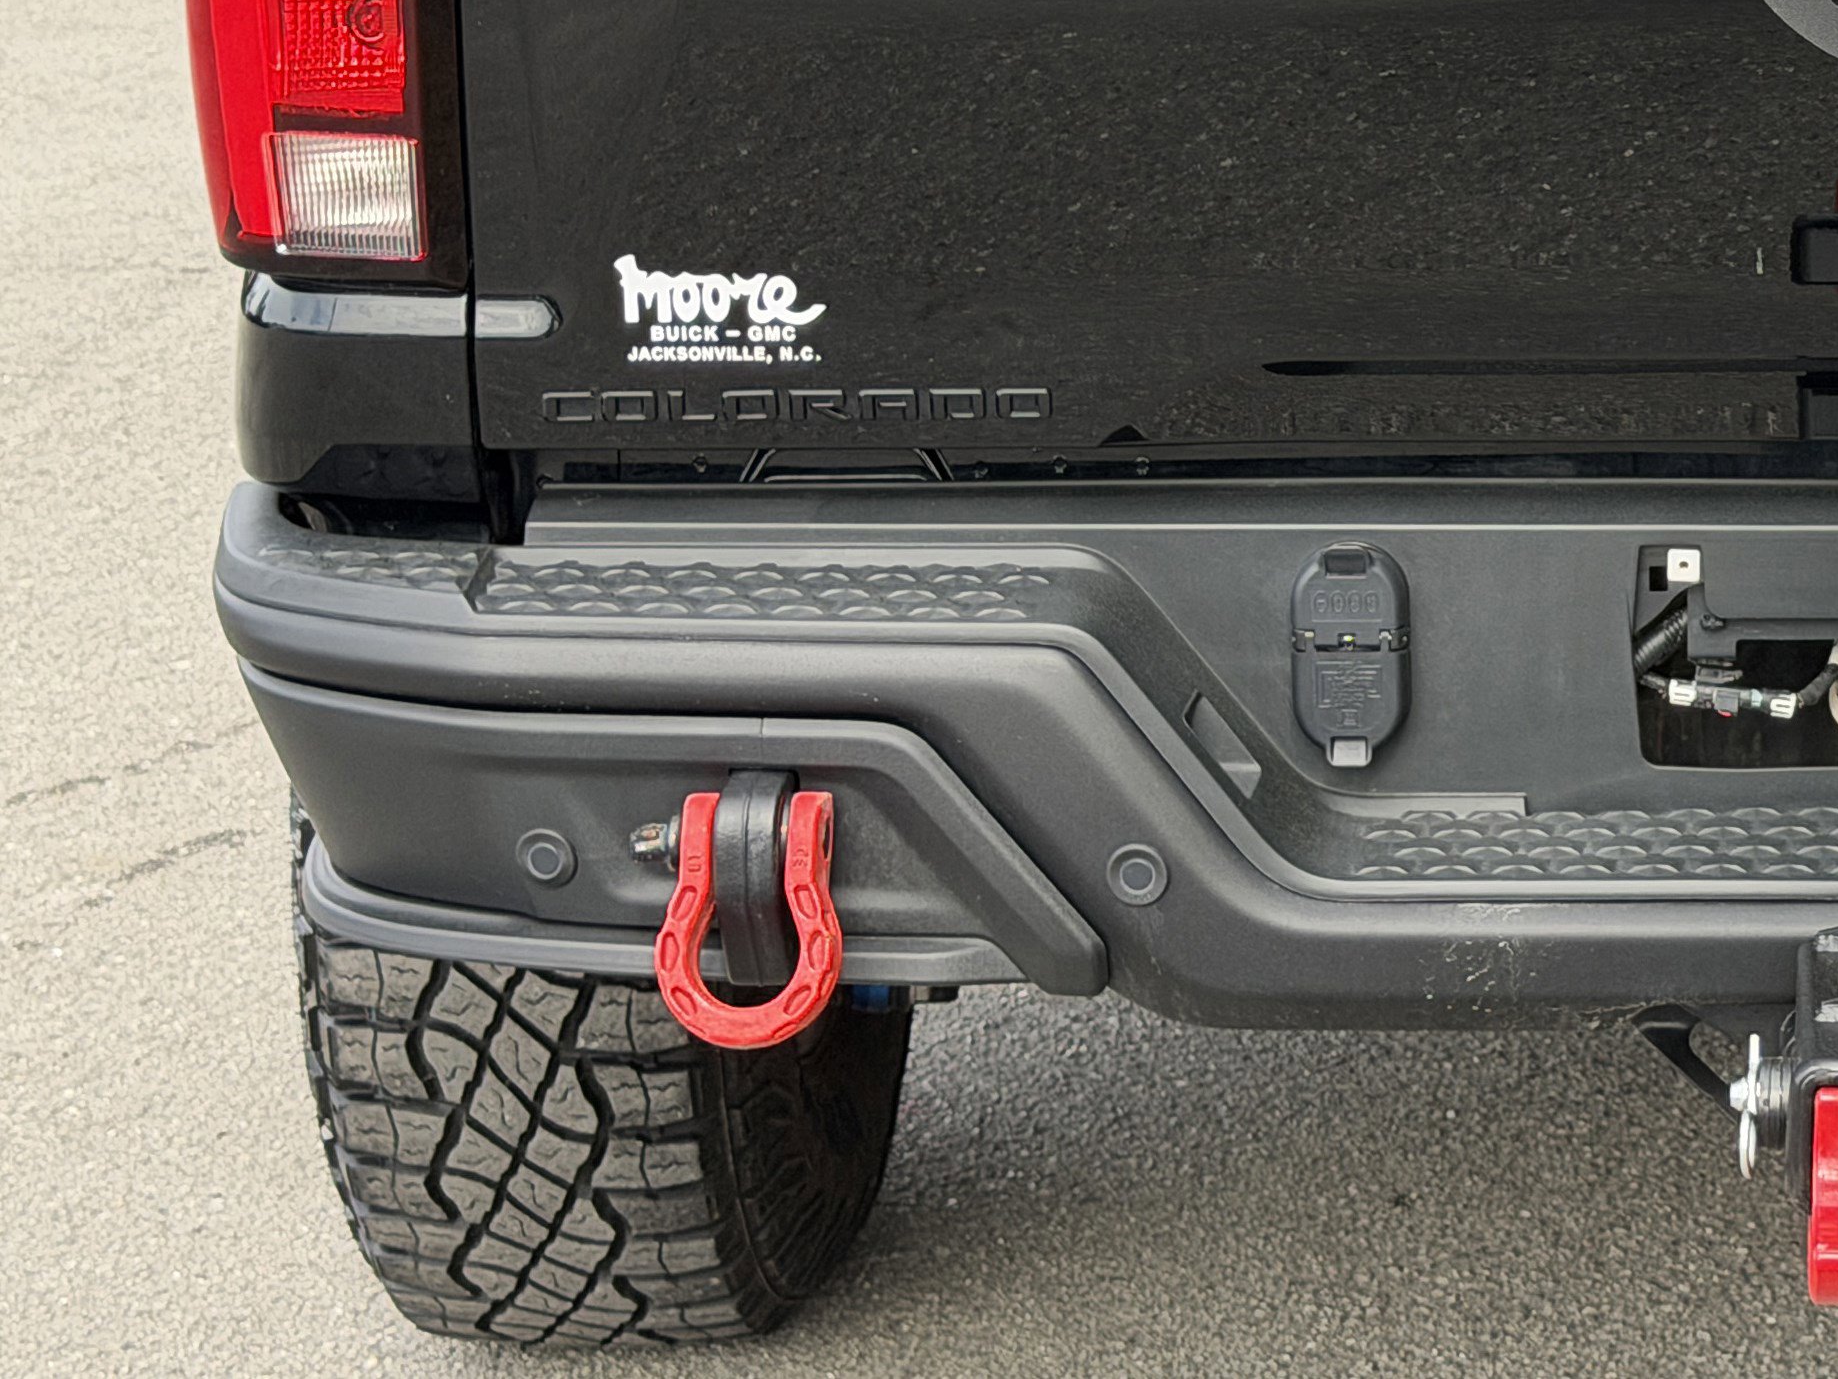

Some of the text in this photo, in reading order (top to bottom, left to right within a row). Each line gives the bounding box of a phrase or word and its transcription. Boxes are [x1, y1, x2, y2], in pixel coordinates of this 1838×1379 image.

[650, 325, 719, 342] BUICK
[747, 325, 797, 342] GMC
[627, 346, 822, 365] JACKSONVILLE, N.C.
[542, 387, 1053, 423] COLORADO
